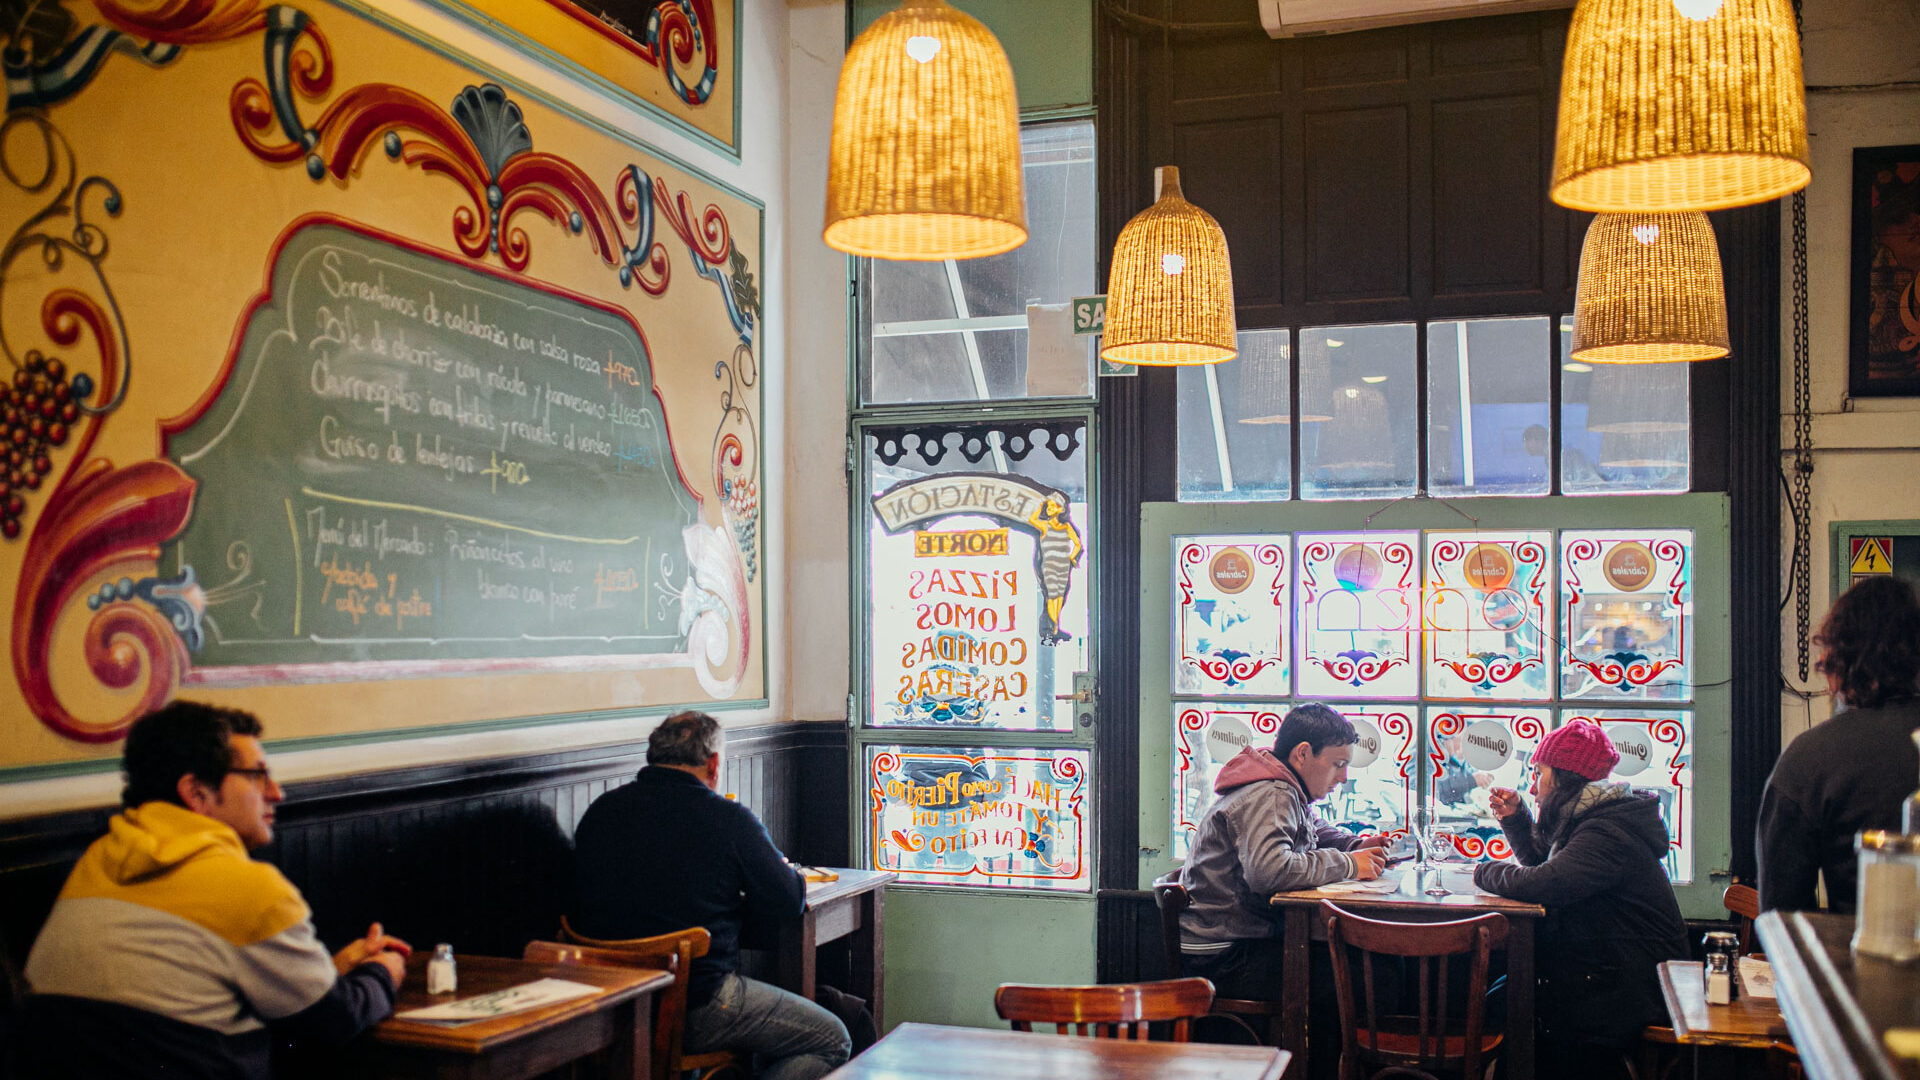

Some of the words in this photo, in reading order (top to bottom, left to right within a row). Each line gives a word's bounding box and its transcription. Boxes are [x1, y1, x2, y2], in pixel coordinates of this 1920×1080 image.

[371, 319, 387, 355] de
[456, 360, 481, 384] con
[423, 290, 441, 327] de
[513, 332, 535, 353] con
[540, 334, 569, 364] salsa
[573, 352, 601, 375] rosa
[320, 415, 379, 459] Guiso
[386, 430, 406, 464] de
[415, 432, 475, 481] lentejas
